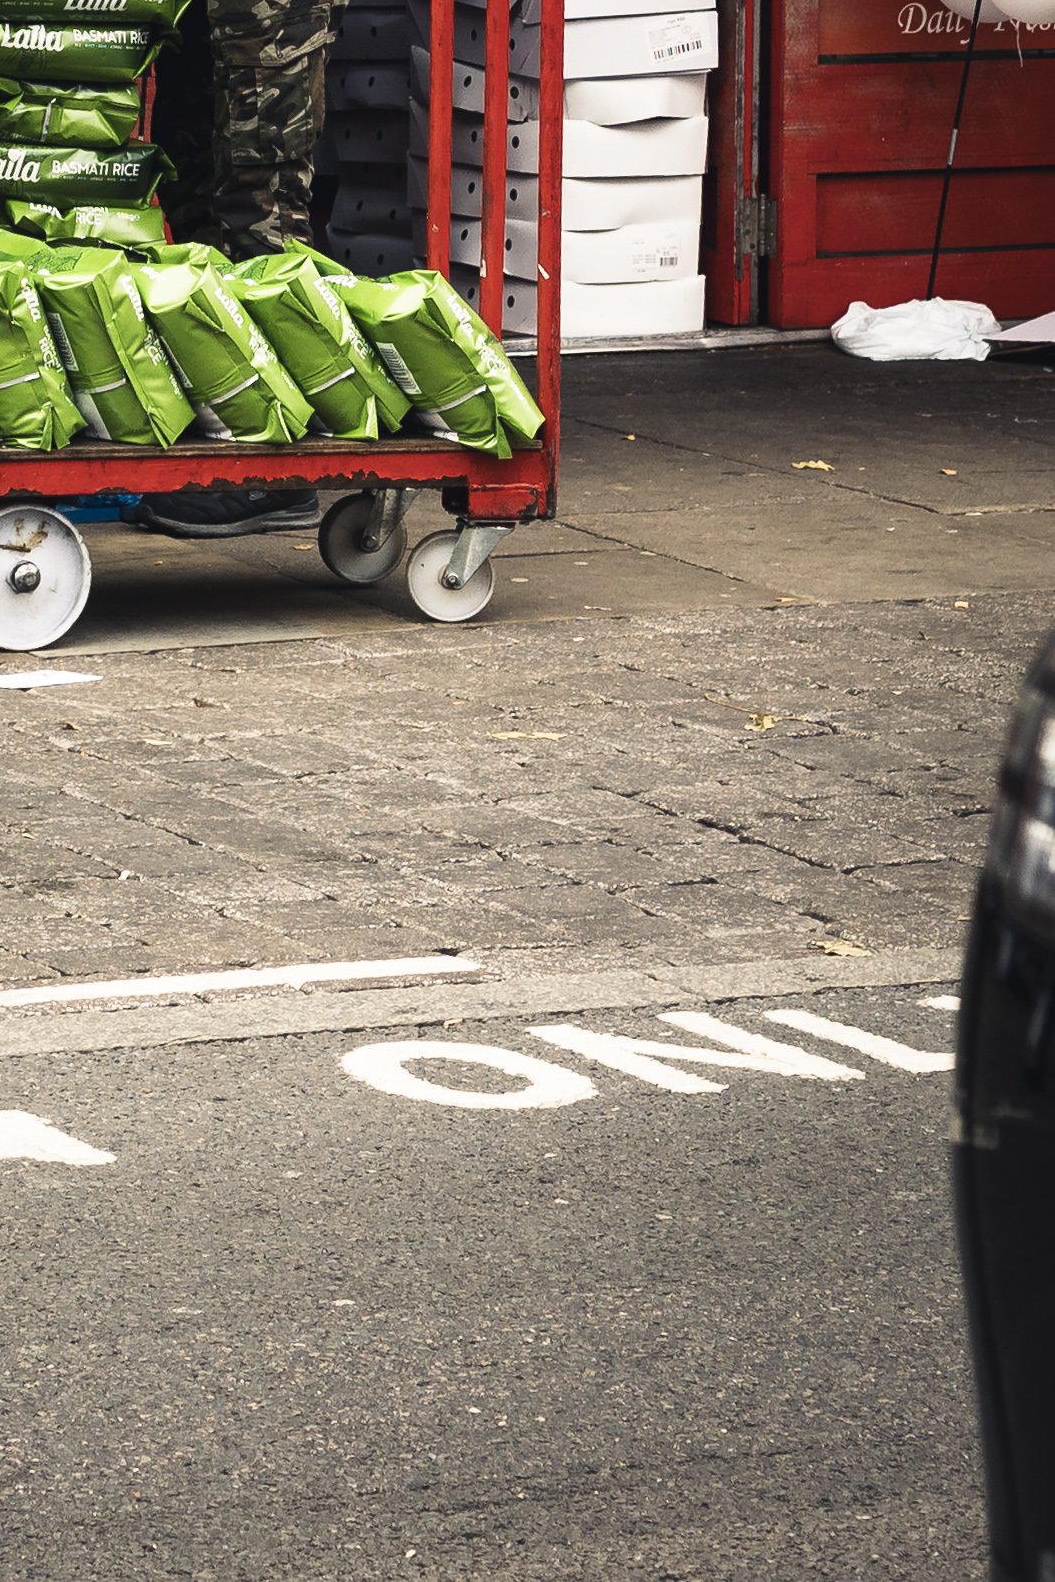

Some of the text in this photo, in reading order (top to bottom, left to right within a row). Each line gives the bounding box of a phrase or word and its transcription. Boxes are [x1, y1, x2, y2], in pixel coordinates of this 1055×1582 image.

[0, 23, 66, 52] Laila
[72, 29, 126, 44] BASMATI
[51, 160, 110, 176] BASMATI
[112, 162, 140, 177] RICE
[214, 287, 245, 329] Laila
[341, 995, 961, 1110] ONL
